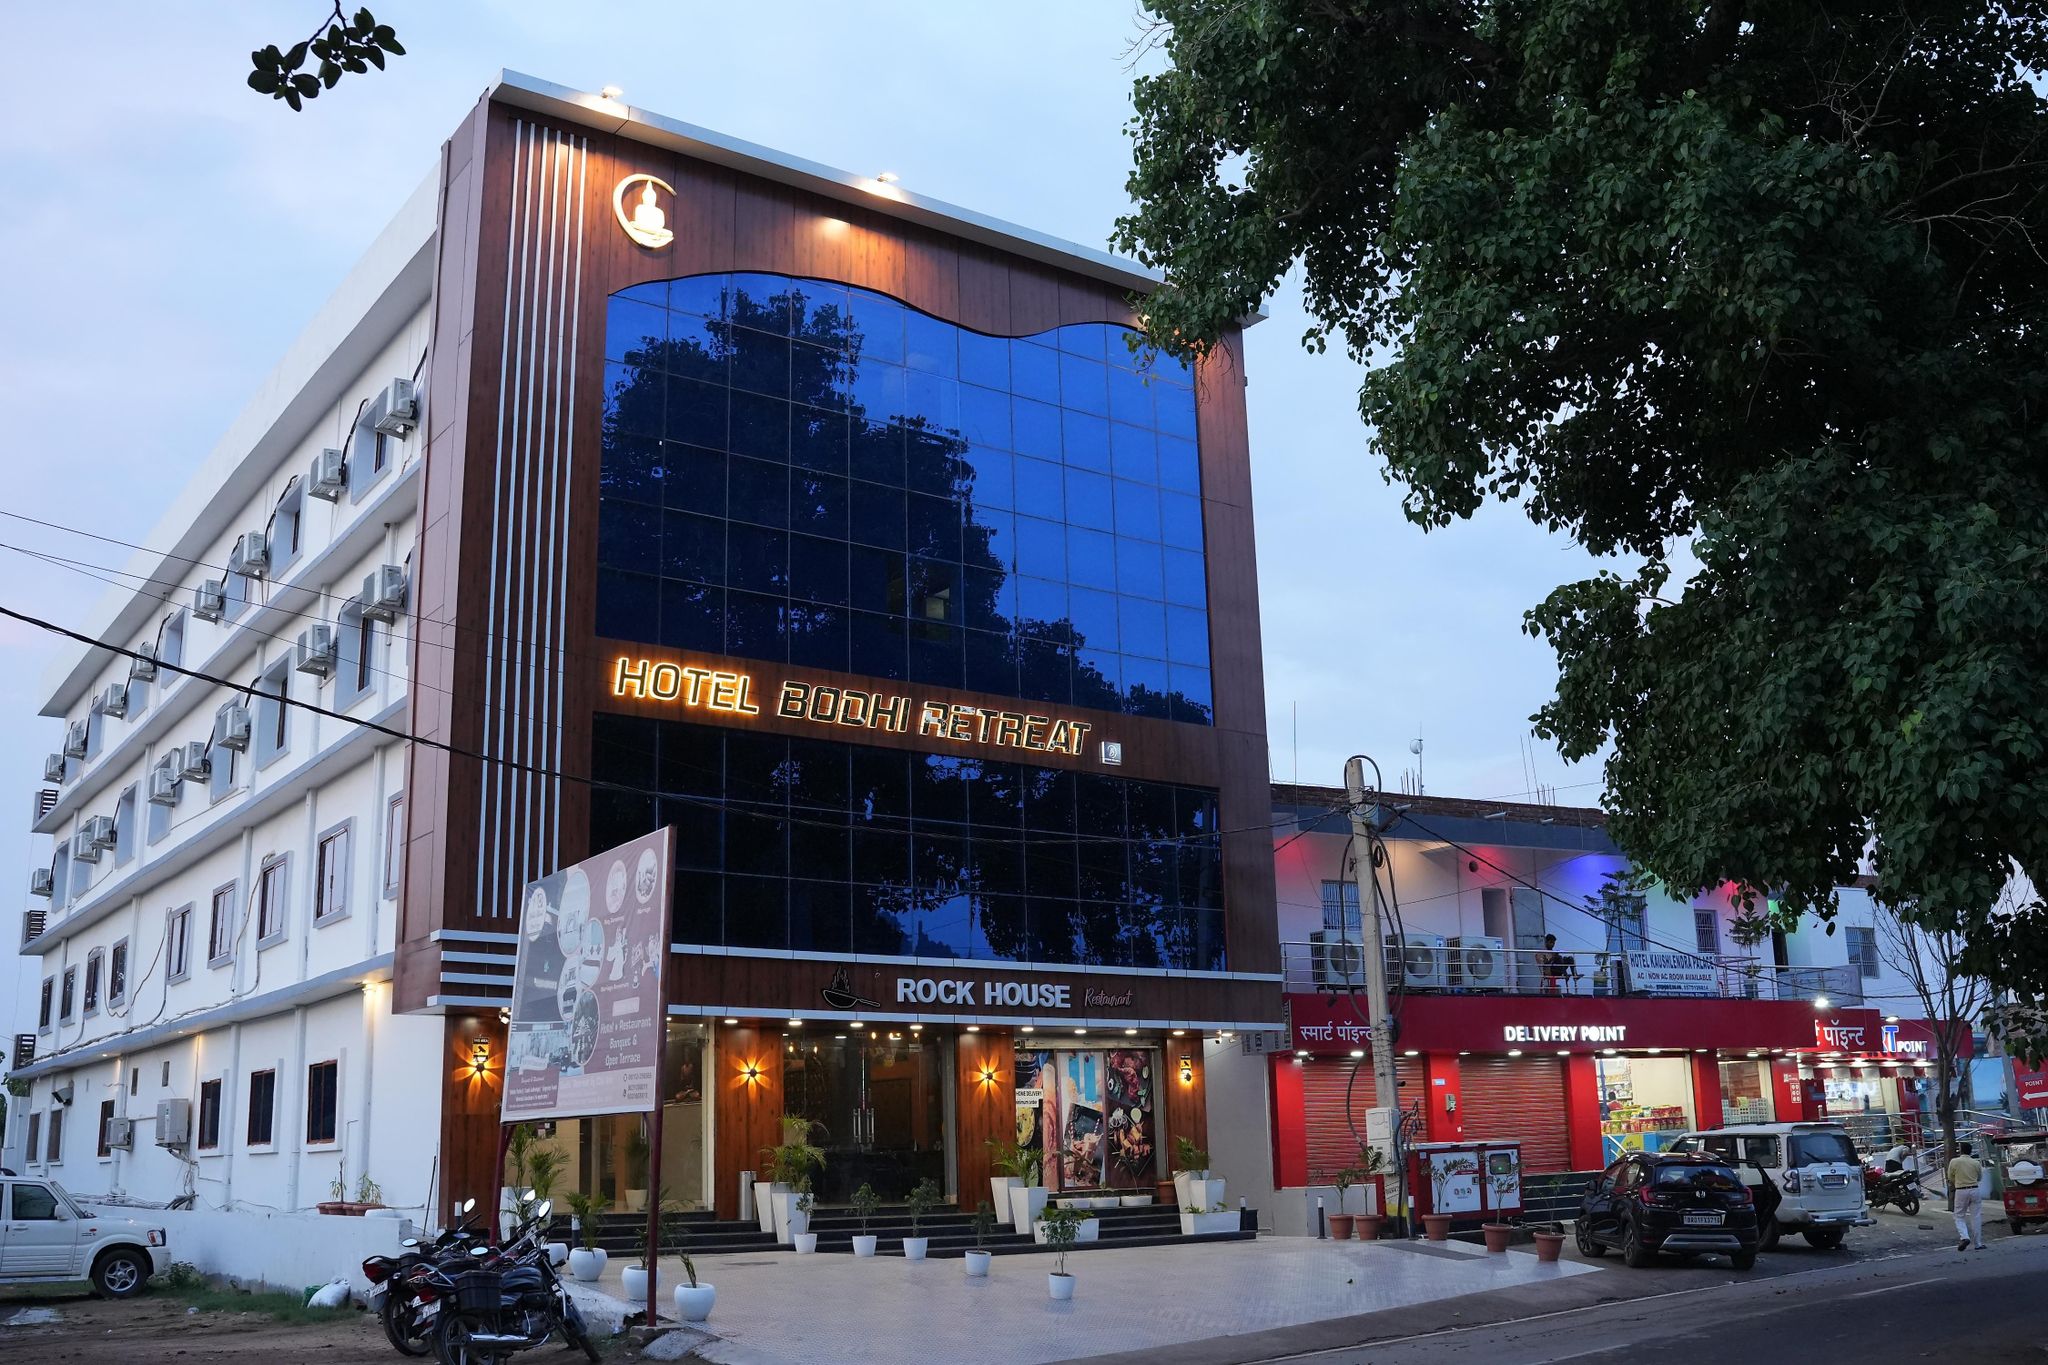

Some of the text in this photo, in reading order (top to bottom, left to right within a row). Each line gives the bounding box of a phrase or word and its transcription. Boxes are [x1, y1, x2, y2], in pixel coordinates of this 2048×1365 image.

[613, 657, 1093, 757] HOTEL BODHI RETREAT
[1629, 953, 1651, 968] HOTEL
[1650, 954, 1693, 970] KAUSHLENDRA
[1669, 973, 1684, 981] ROOM
[1685, 973, 1712, 981] AVAILABLE
[896, 977, 1071, 1010] ROCK HOUSE
[1083, 986, 1134, 1008] Restaurant
[1300, 1020, 1333, 1041] स्मार्ट
[1504, 1025, 1627, 1042] DELIVERY POINT
[1822, 1019, 1866, 1050] पॉइन्ट
[1897, 1040, 1928, 1053] POINT
[2025, 1079, 2044, 1088] POINT
